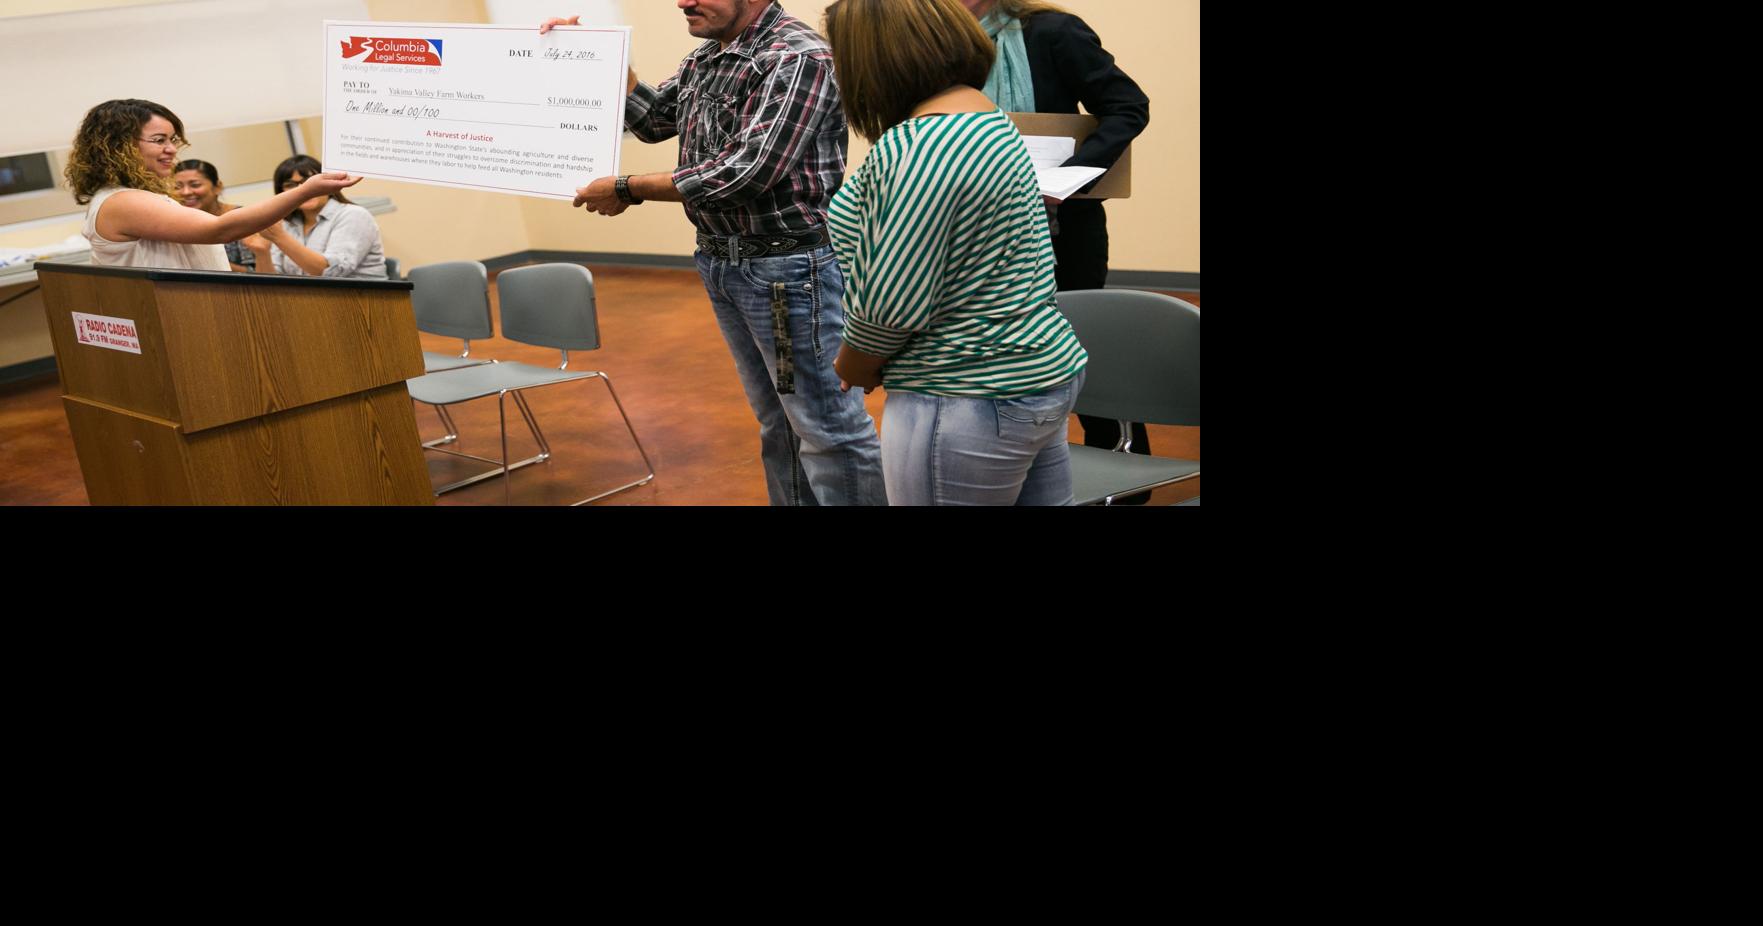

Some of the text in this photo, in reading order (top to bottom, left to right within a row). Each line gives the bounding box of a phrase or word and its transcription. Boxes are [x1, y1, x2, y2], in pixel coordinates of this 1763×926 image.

[375, 40, 426, 53] Columbia
[375, 53, 426, 63] Legal Services
[509, 49, 533, 58] DATE
[544, 47, 560, 60] July
[576, 50, 596, 60] 2016
[341, 63, 369, 73] Working
[380, 65, 403, 74] Justice
[404, 66, 424, 74] Since
[425, 67, 441, 75] 1967
[343, 80, 370, 89] PAY TO
[388, 87, 485, 101] Yakima Valley Farm Workers
[547, 96, 602, 108] $1,000,000.00
[345, 100, 440, 120] One Million and 00/100
[560, 121, 598, 132] DOLLARS
[433, 130, 459, 139] Harvest
[460, 132, 469, 140] of
[469, 133, 494, 142] Justice
[391, 139, 424, 147] contribution
[434, 141, 467, 152] Washington
[489, 146, 520, 157] abounding
[522, 150, 554, 160] agriculture
[557, 153, 569, 161] and
[571, 154, 594, 163] diverse
[380, 154, 411, 163] warehouses
[411, 156, 428, 164] where
[428, 159, 441, 167] they
[441, 160, 457, 168] labor
[464, 162, 478, 170] help
[499, 166, 534, 176] Washington
[391, 147, 424, 157] appreciation
[432, 150, 446, 158] their
[446, 152, 472, 162] struggles
[480, 156, 509, 164] overcome
[509, 158, 552, 168] discrimination
[566, 163, 593, 173] hardship
[86, 319, 136, 337] RADIO CADENA
[101, 335, 109, 343] FM
